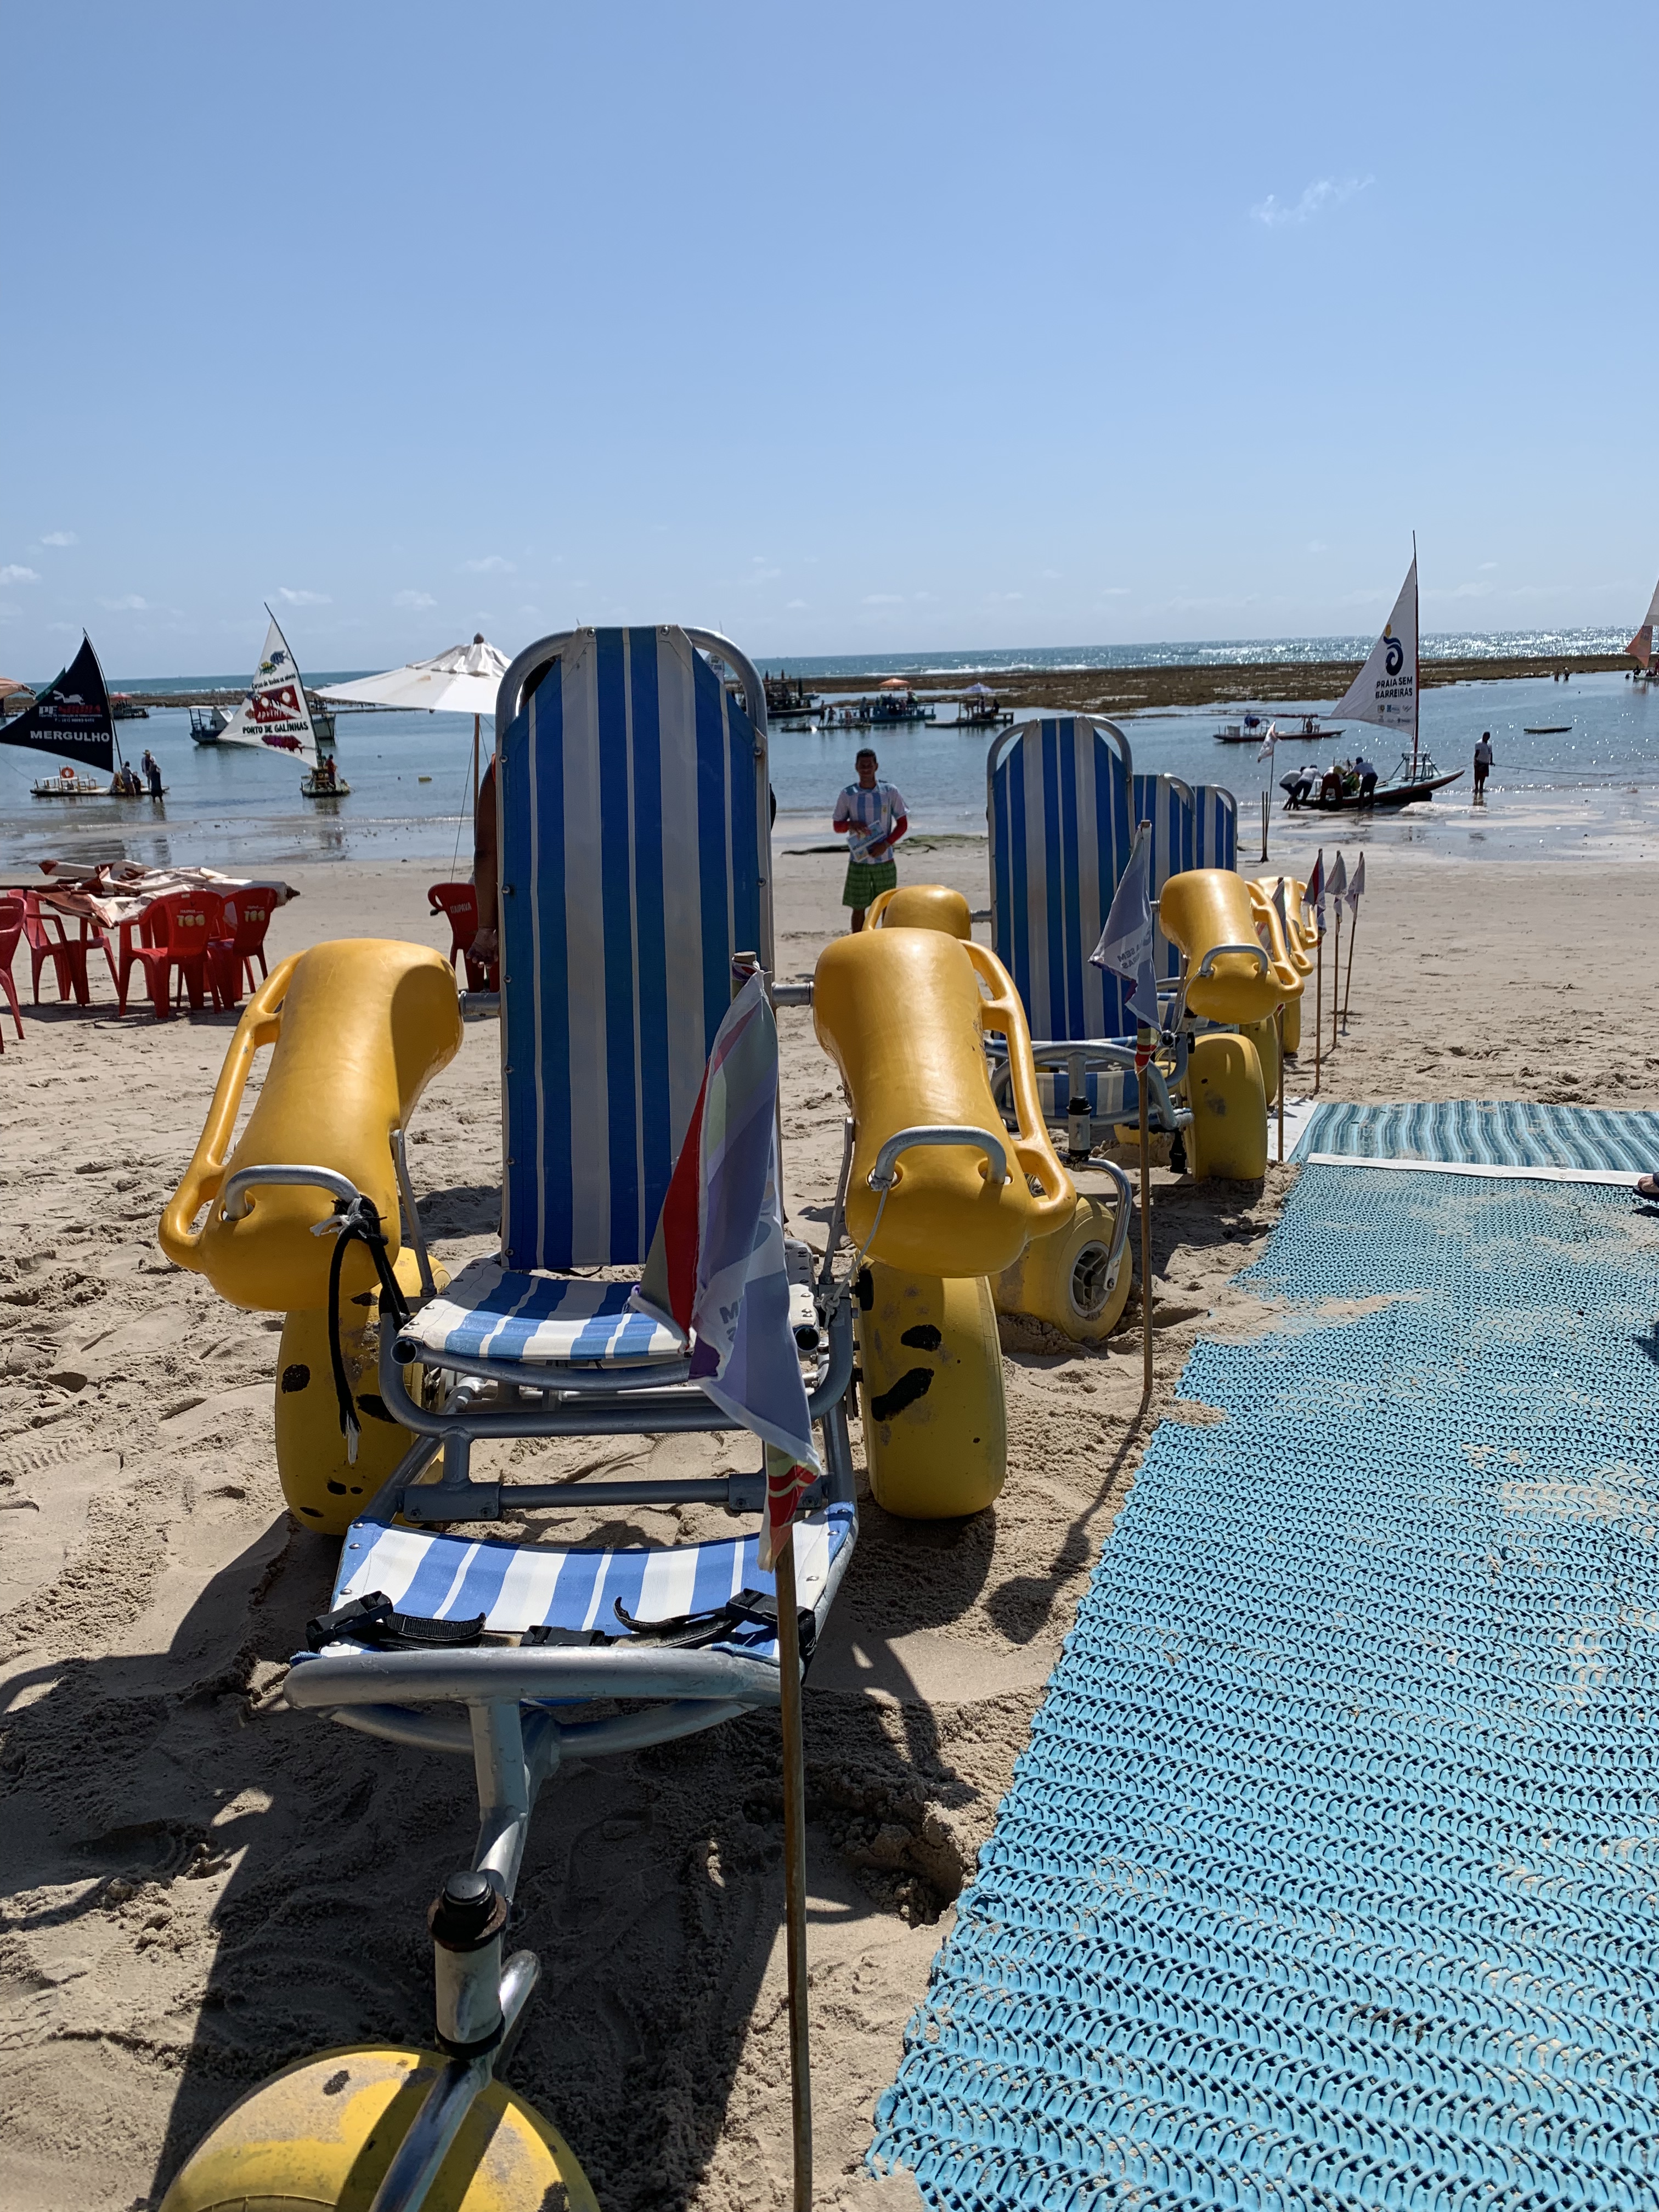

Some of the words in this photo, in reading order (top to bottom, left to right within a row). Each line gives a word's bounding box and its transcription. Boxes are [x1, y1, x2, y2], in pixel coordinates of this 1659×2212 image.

[1376, 679, 1397, 689] PRAIA
[1398, 676, 1413, 685] SEM
[1375, 687, 1413, 699] BARREIRAS
[242, 725, 263, 734] PORTO
[264, 725, 273, 733] DE
[30, 731, 110, 742] MERGULHO
[450, 902, 472, 913] ITAIPAVA
